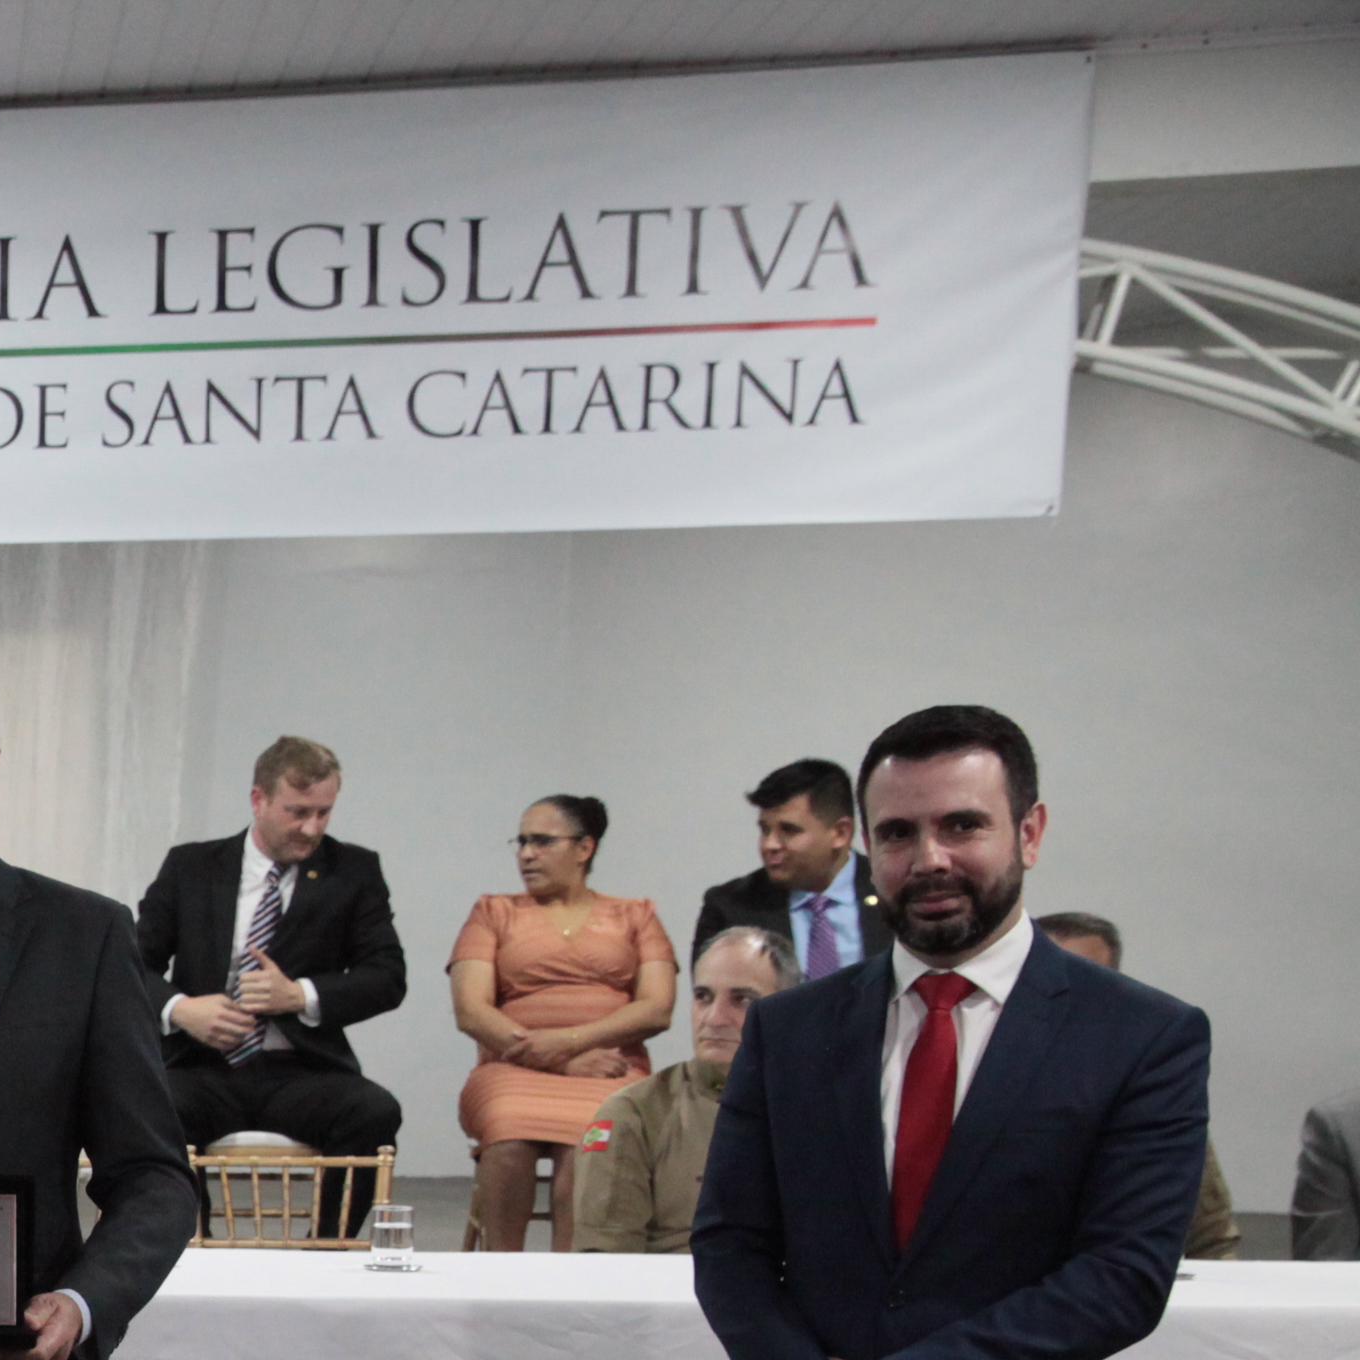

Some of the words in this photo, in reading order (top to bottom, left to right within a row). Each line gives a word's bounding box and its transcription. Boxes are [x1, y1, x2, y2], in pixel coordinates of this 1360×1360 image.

[148, 200, 877, 317] LEGISLATIVA
[100, 373, 384, 449] SANTA
[405, 356, 867, 440] CATARINA
